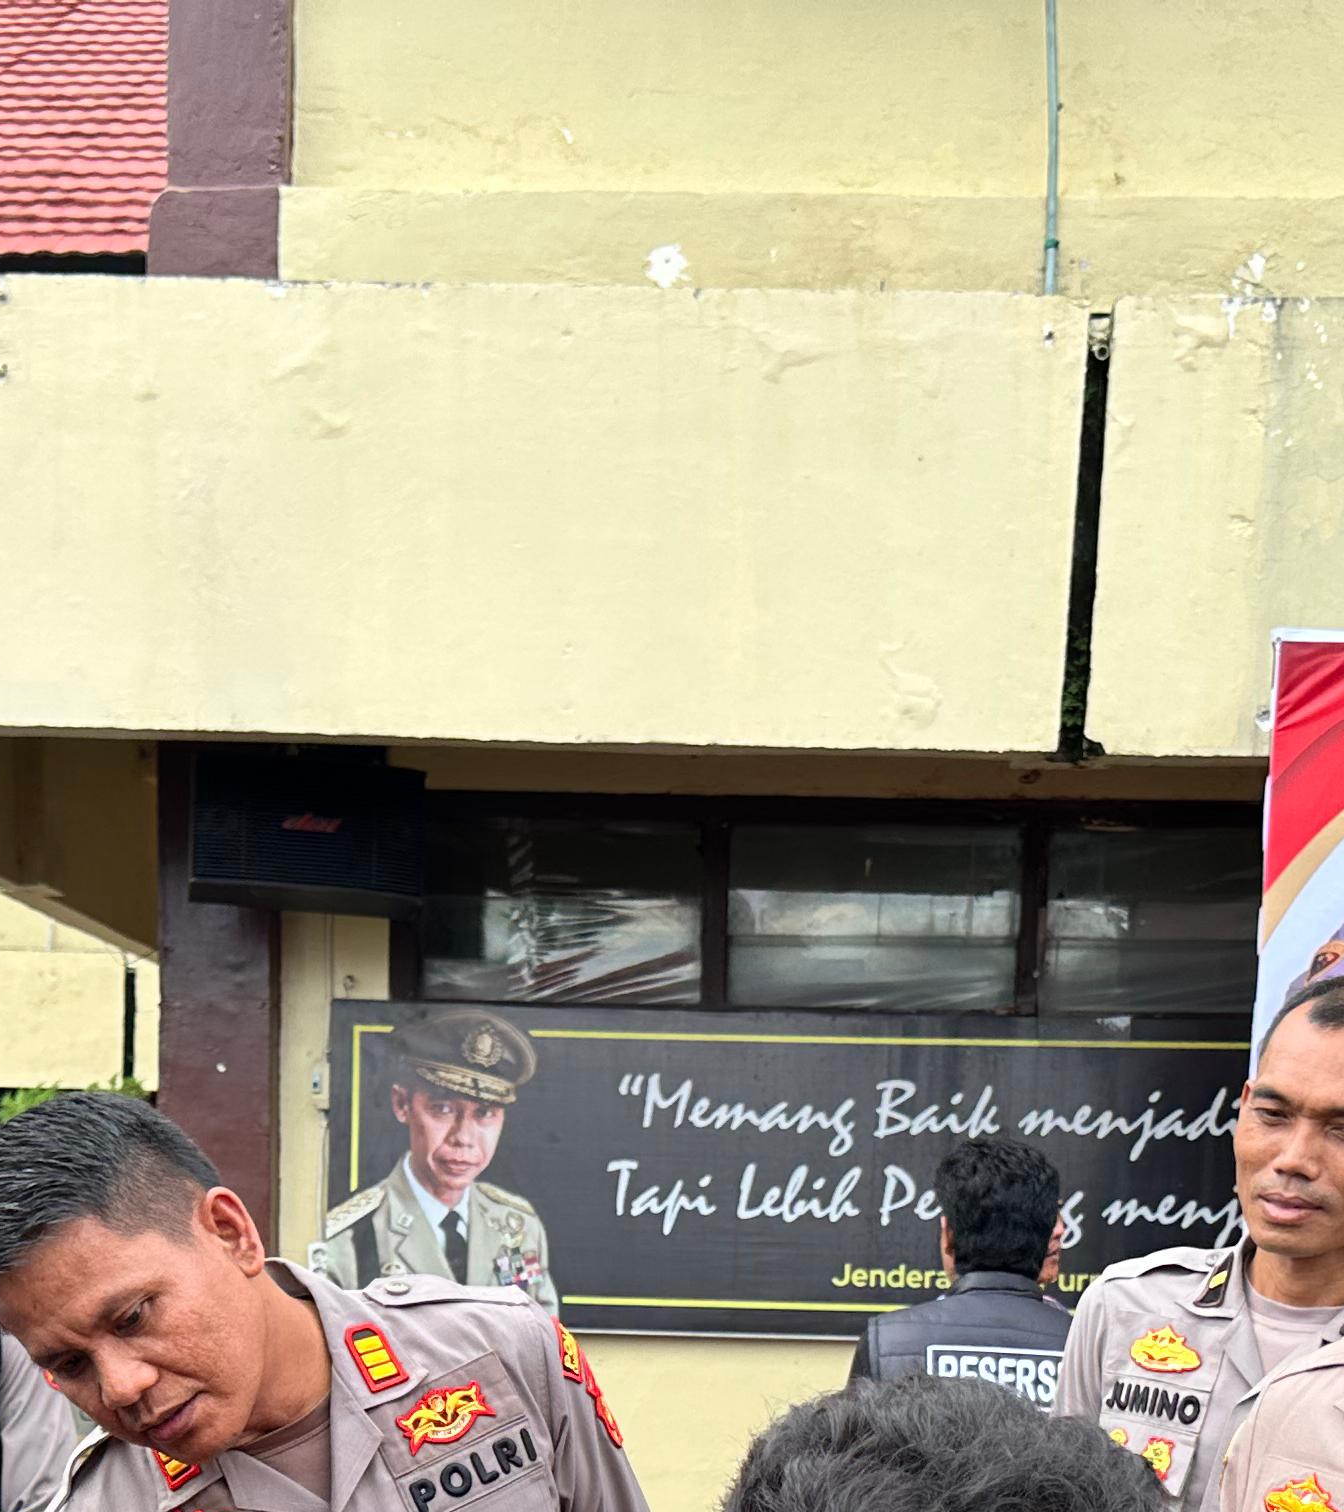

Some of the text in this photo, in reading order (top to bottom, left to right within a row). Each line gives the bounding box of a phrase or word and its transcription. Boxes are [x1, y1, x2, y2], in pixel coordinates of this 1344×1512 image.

[873, 1079, 1000, 1139] Baik
[607, 1159, 717, 1235] Tapi
[736, 1162, 863, 1223] Lebih
[1106, 1381, 1201, 1426] JUMINO
